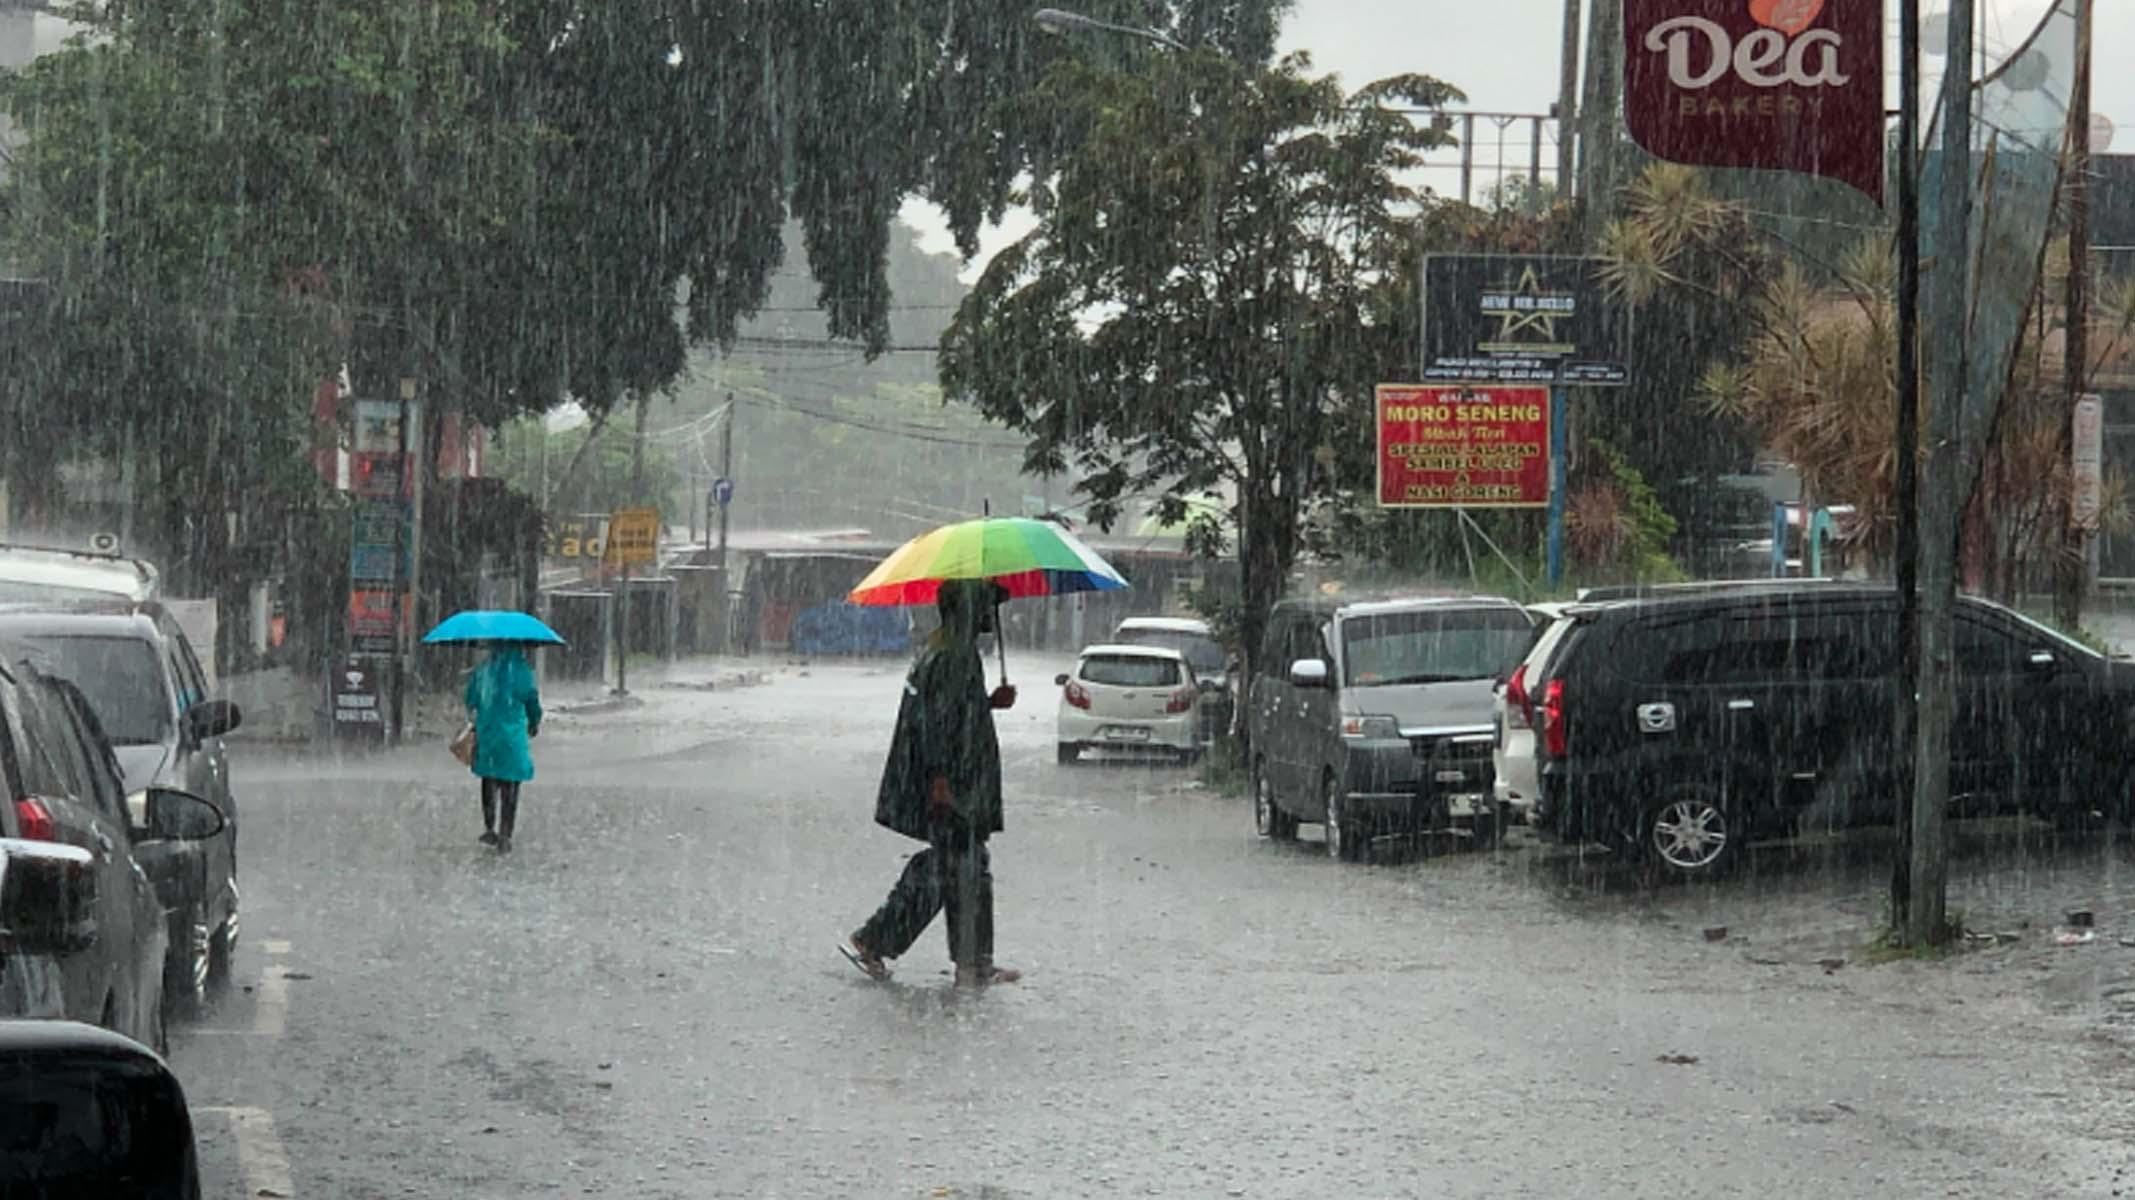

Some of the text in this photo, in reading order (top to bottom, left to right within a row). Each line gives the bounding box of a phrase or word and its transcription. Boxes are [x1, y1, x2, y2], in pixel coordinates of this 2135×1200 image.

[1645, 16, 1850, 89] Dea
[1680, 96, 1824, 116] BAKERY
[1387, 405, 1540, 421] MORO SENENG
[1405, 486, 1521, 499] NASI GORENG
